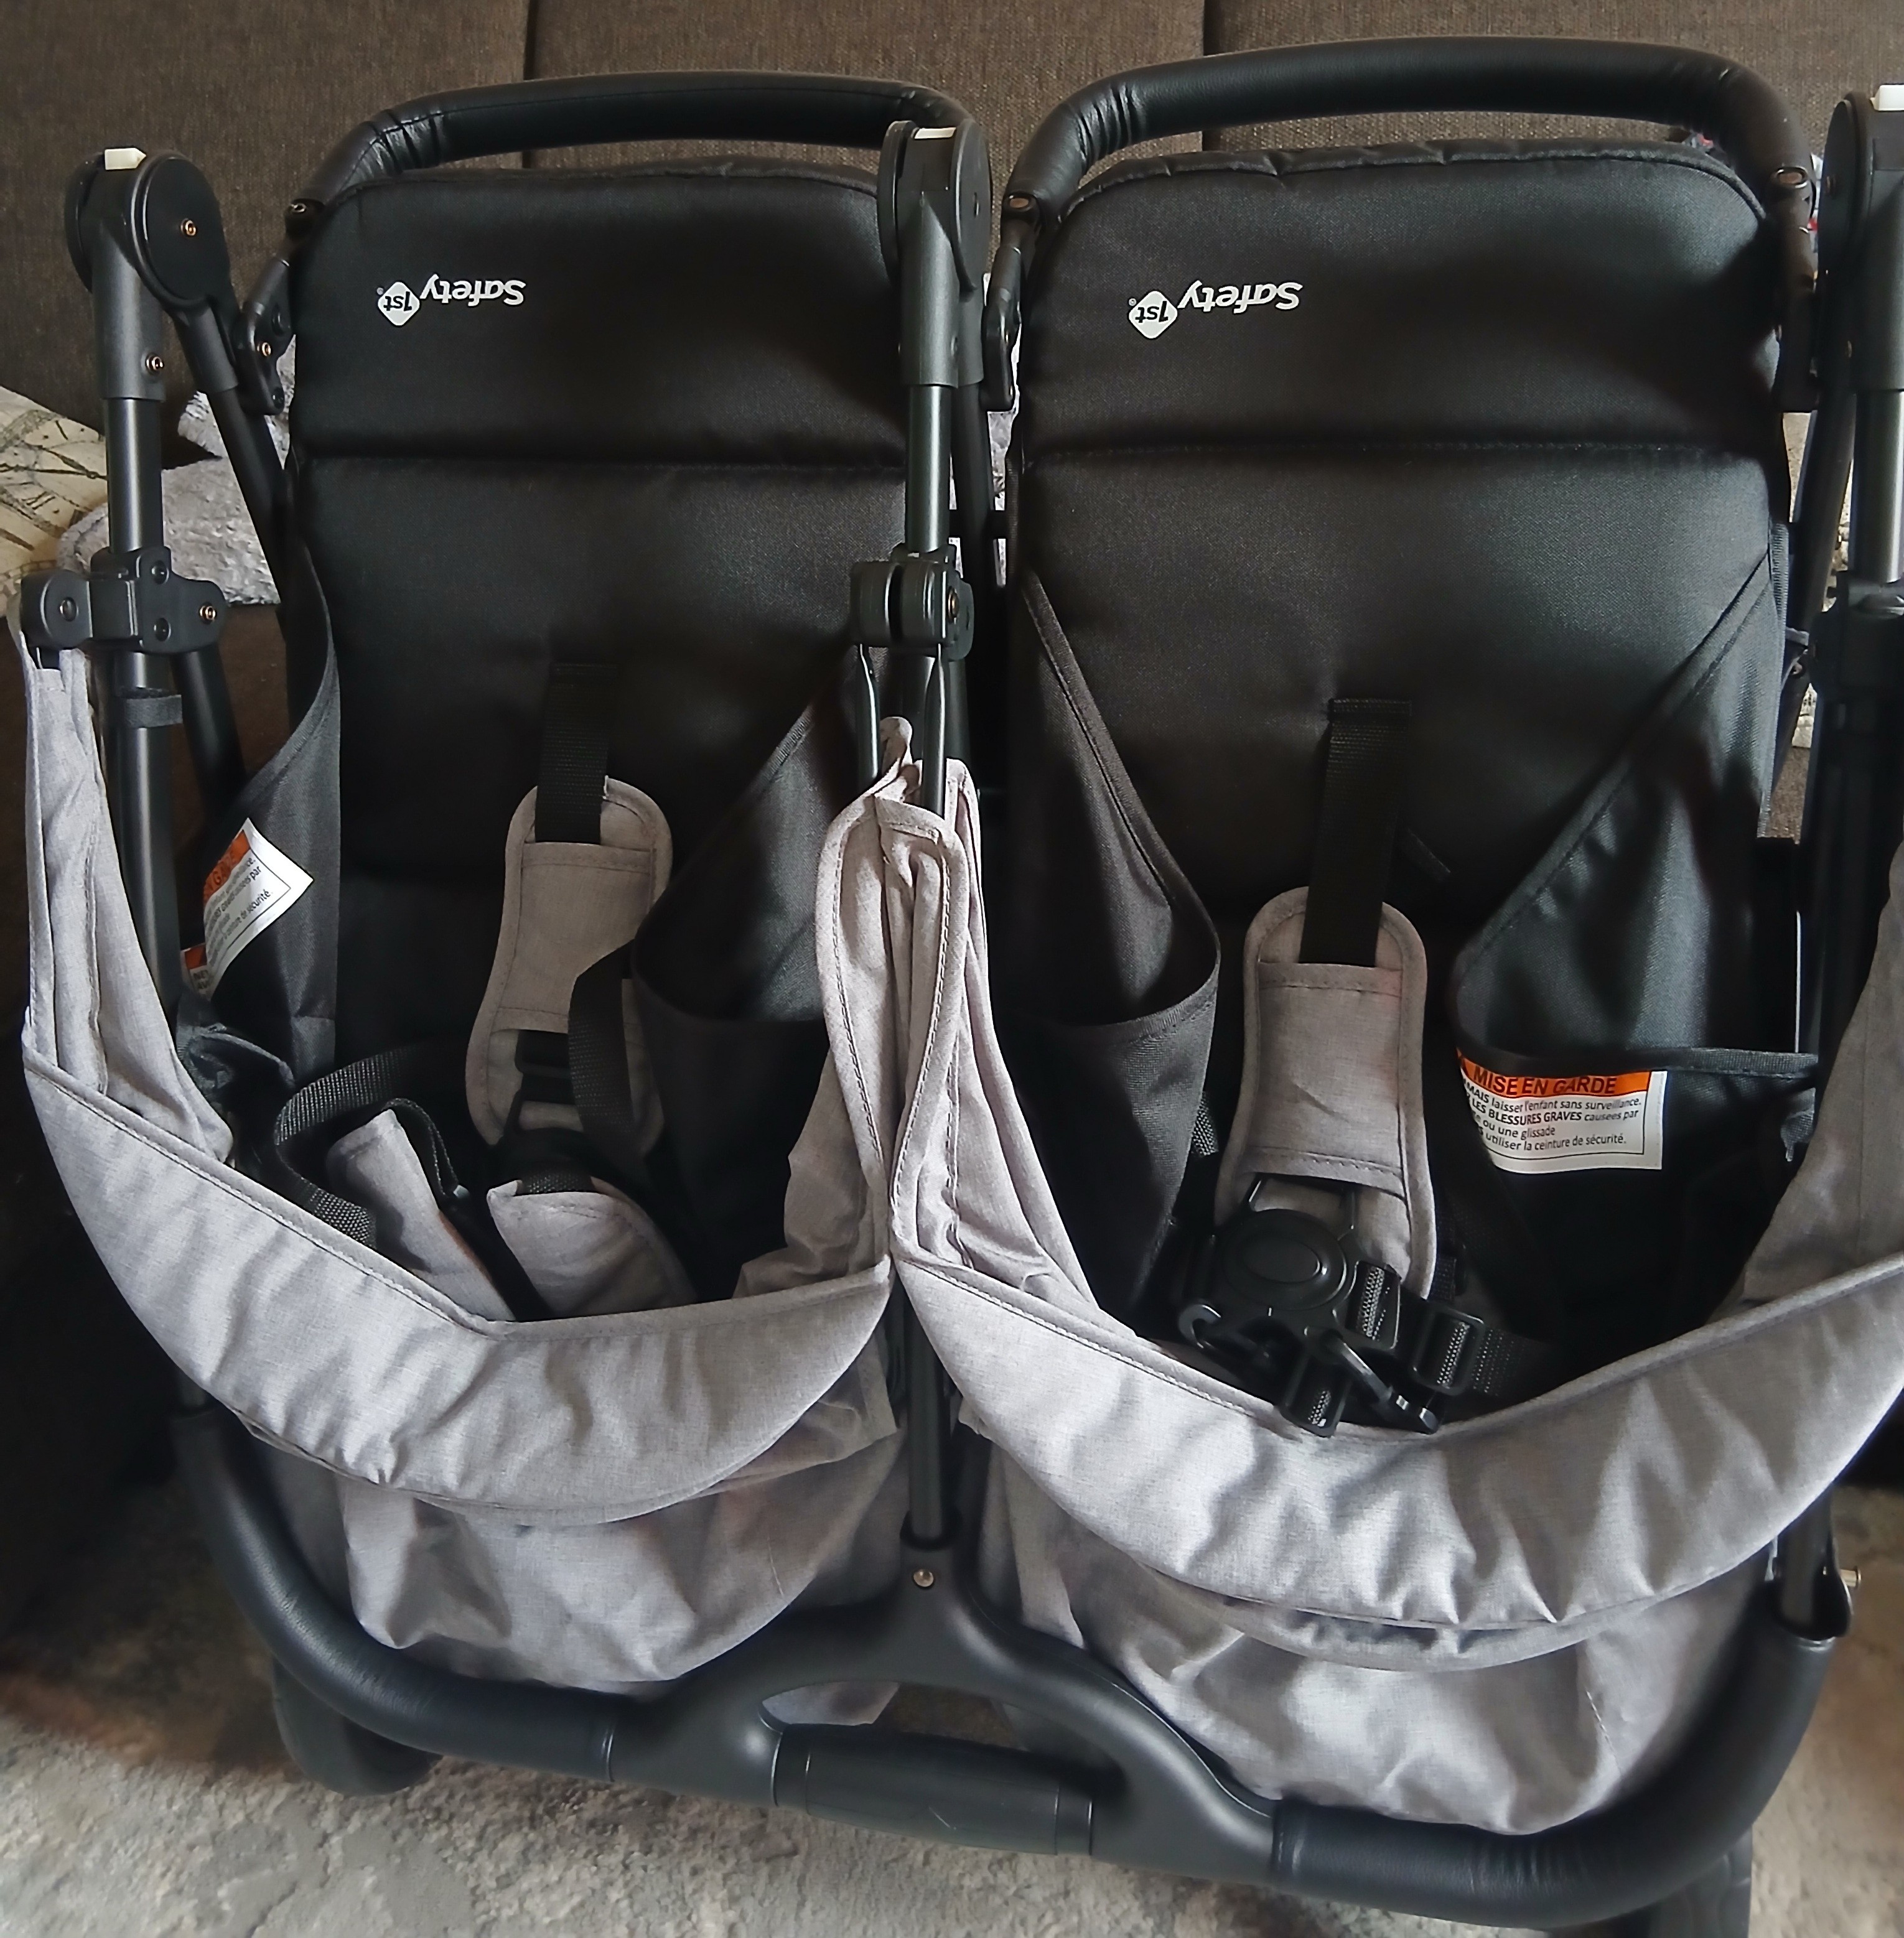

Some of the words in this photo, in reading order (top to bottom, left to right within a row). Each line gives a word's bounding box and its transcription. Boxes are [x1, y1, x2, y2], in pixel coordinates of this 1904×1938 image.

[383, 291, 413, 312] 1st
[419, 274, 526, 307] Safety
[1177, 280, 1303, 314] Safety
[1135, 300, 1169, 324] 1st
[1473, 1066, 1519, 1095] MISE
[1521, 1078, 1548, 1094] EN
[1553, 1076, 1617, 1094] GARDE
[1463, 1079, 1490, 1103] MAIS
[1491, 1097, 1523, 1113] laisser
[1560, 1101, 1582, 1109] sans
[1472, 1098, 1486, 1114] LES
[1488, 1108, 1541, 1125] BLESSURES
[1544, 1111, 1582, 1122] GRAVES
[1623, 1110, 1639, 1120] par
[1483, 1120, 1495, 1131] ou
[1498, 1127, 1518, 1138] une
[1521, 1125, 1556, 1140] glissade
[1486, 1133, 1521, 1150] utiliser
[1524, 1140, 1532, 1150] la
[1534, 1139, 1570, 1150] ceinture
[1572, 1135, 1584, 1146] de
[1586, 1133, 1626, 1145] sécurité.
